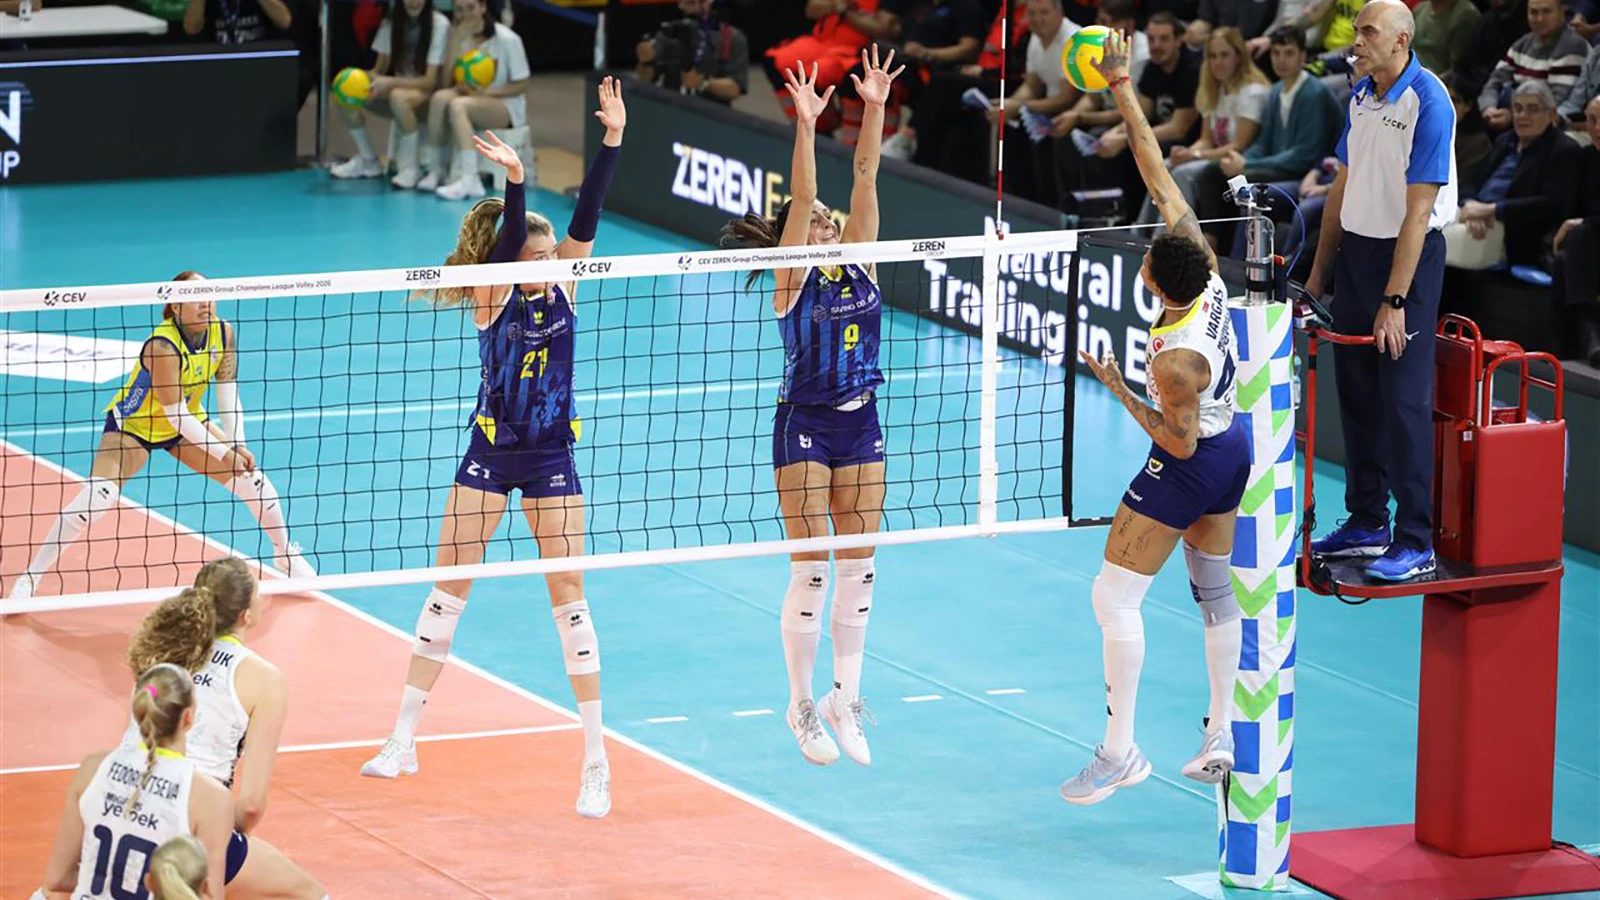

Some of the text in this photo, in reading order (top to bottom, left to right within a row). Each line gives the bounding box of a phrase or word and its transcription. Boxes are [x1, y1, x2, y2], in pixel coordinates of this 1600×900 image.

[1391, 120, 1407, 131] CEV
[671, 141, 763, 217] ZEREN
[912, 240, 946, 252] ZEREN
[588, 262, 612, 274] CEV
[698, 250, 843, 265] CEV ZEREN Group Champions League Volley 2026
[406, 269, 441, 281] ZEREN
[62, 291, 87, 303] CEV
[178, 279, 332, 295] CEV ZEREN Group Champions League Volley 2026
[923, 259, 1066, 366] Traing
[1205, 287, 1223, 340] VARGAS
[843, 323, 859, 352] 9
[520, 347, 548, 379] 21
[107, 761, 180, 801] FEDORTSEVA
[90, 823, 159, 900] 10
